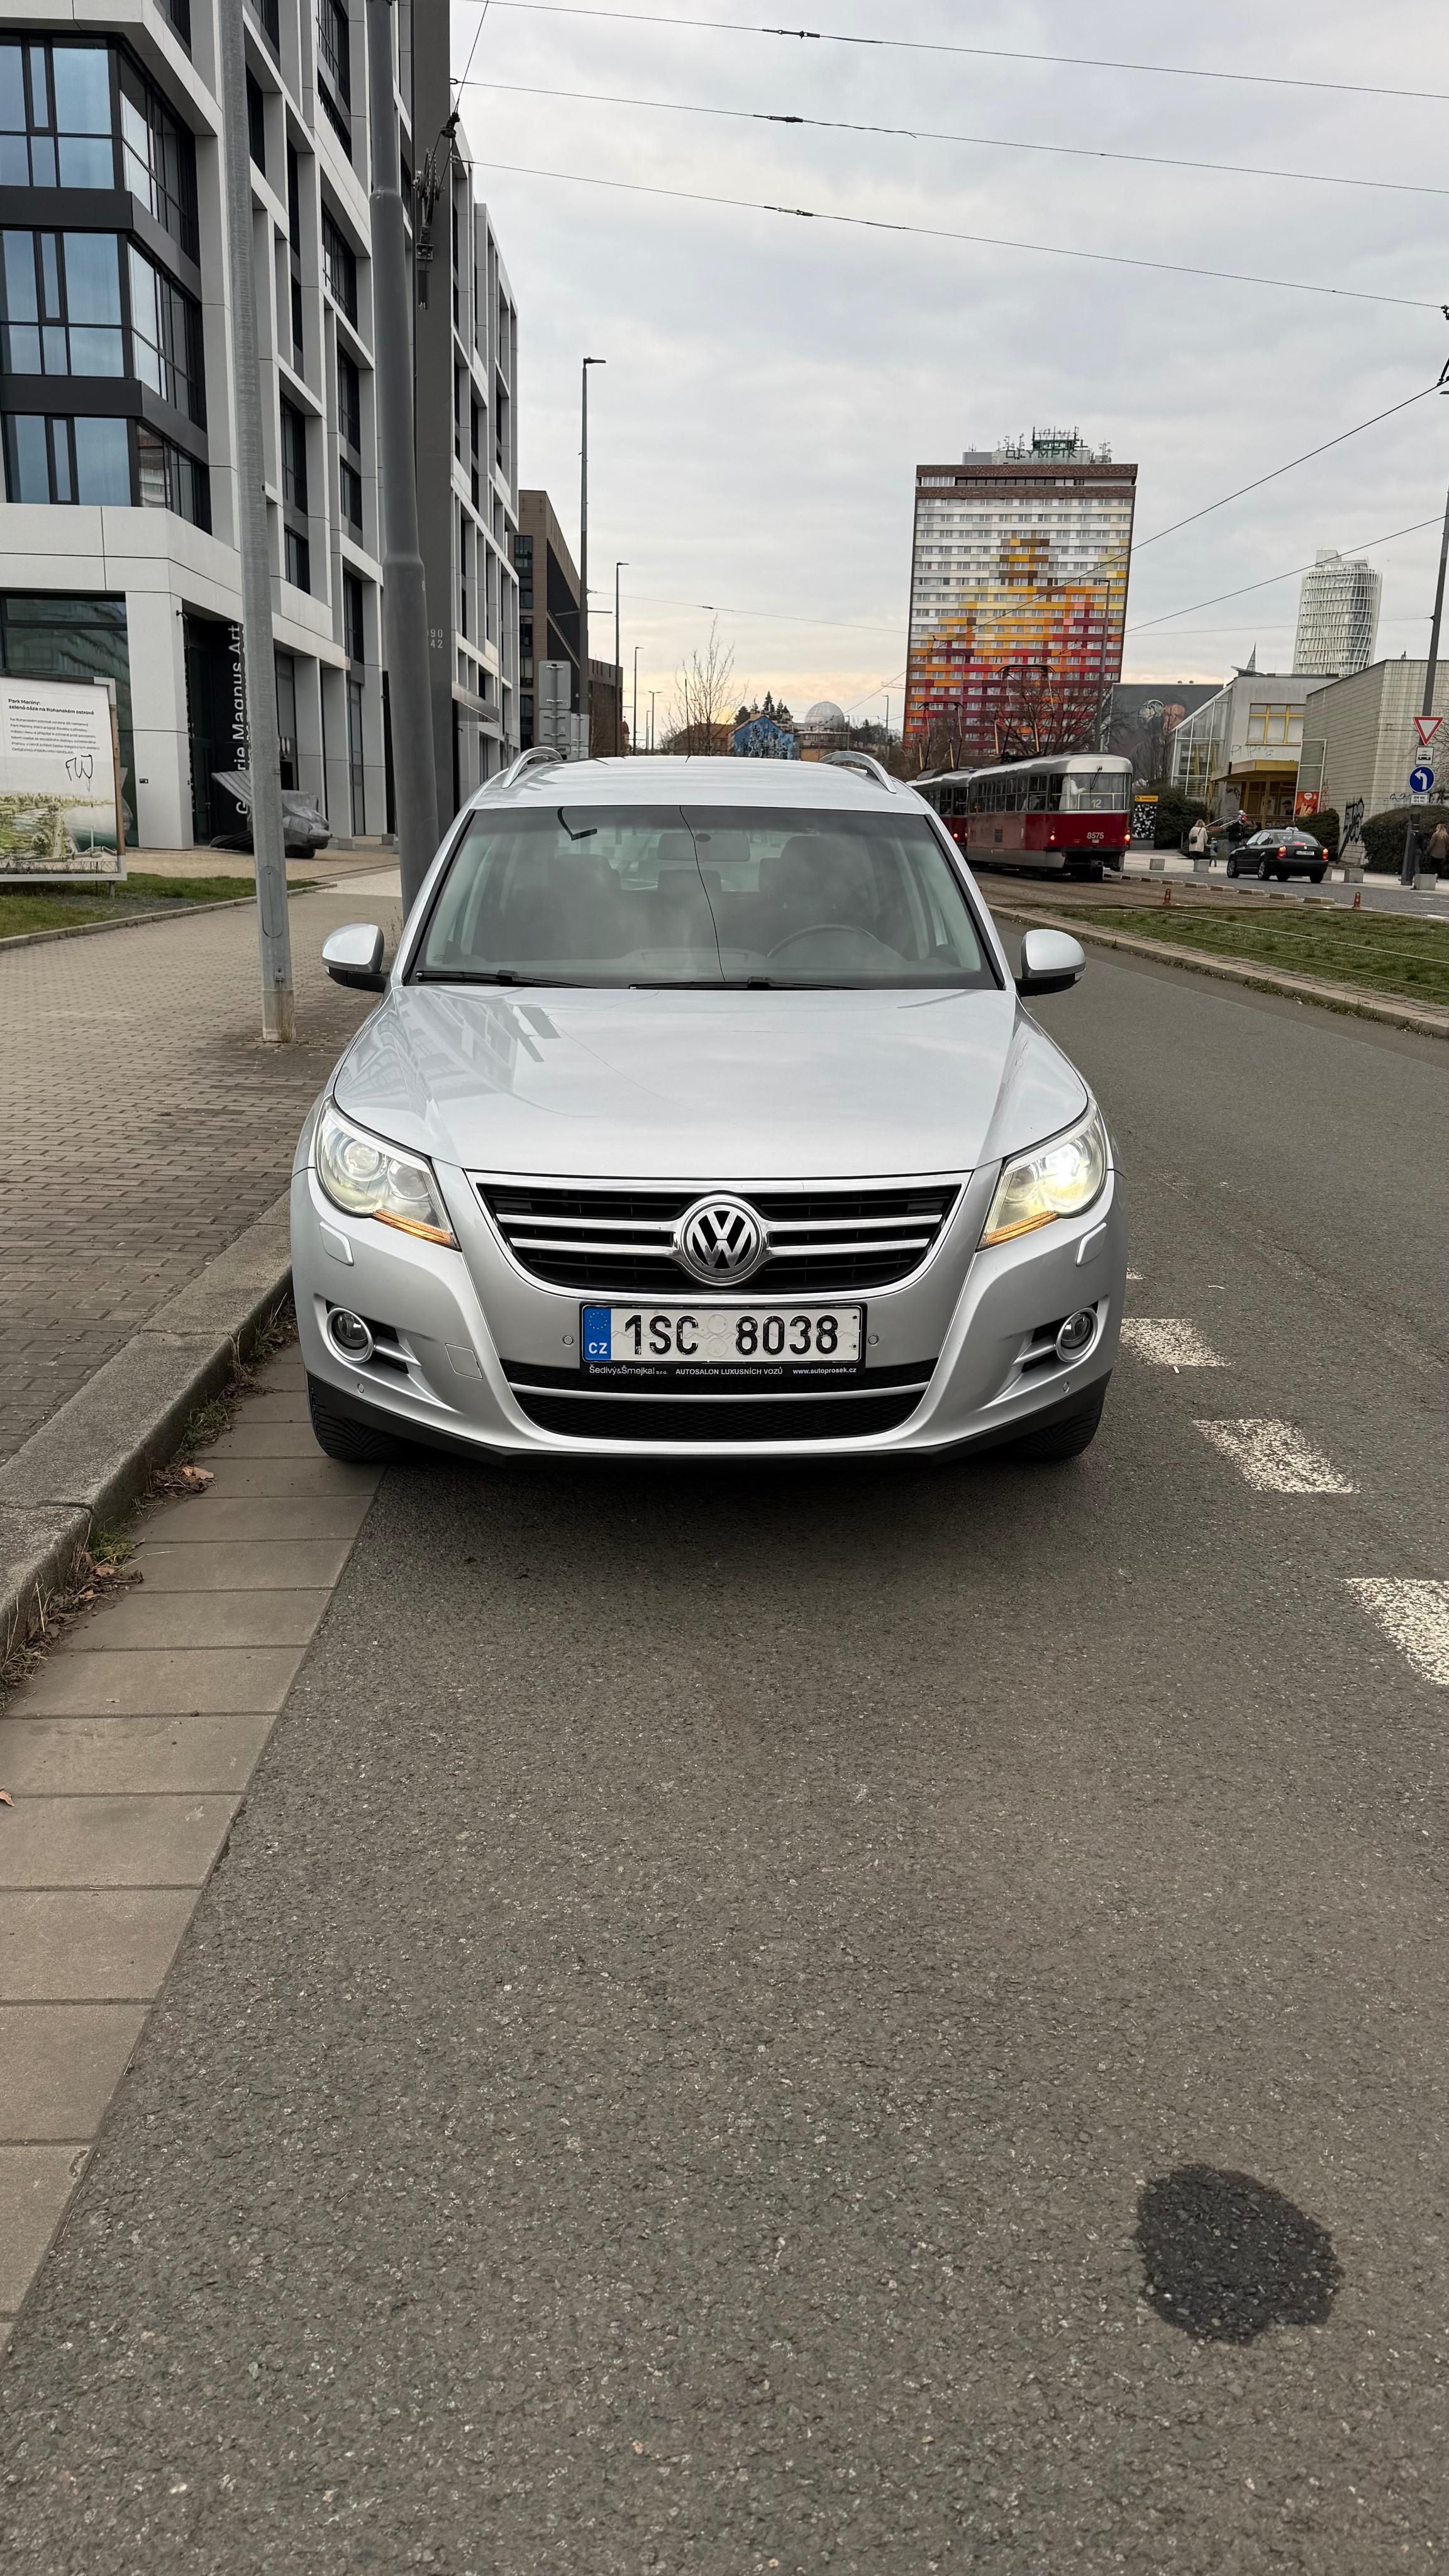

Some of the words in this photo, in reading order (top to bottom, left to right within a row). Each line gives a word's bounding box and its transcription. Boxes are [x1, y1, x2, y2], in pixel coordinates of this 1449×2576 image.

[1006, 449, 1077, 458] OLYMPIK
[428, 629, 443, 638] 90
[228, 624, 241, 654] Art
[430, 639, 443, 648] 42
[232, 662, 245, 740] Magnus
[233, 747, 248, 814] Grie
[1091, 799, 1102, 808] 12
[625, 1315, 699, 1355] 1SC
[735, 1314, 838, 1355] 8038
[589, 1342, 608, 1353] CZ
[763, 1367, 783, 1375] VOZŮ
